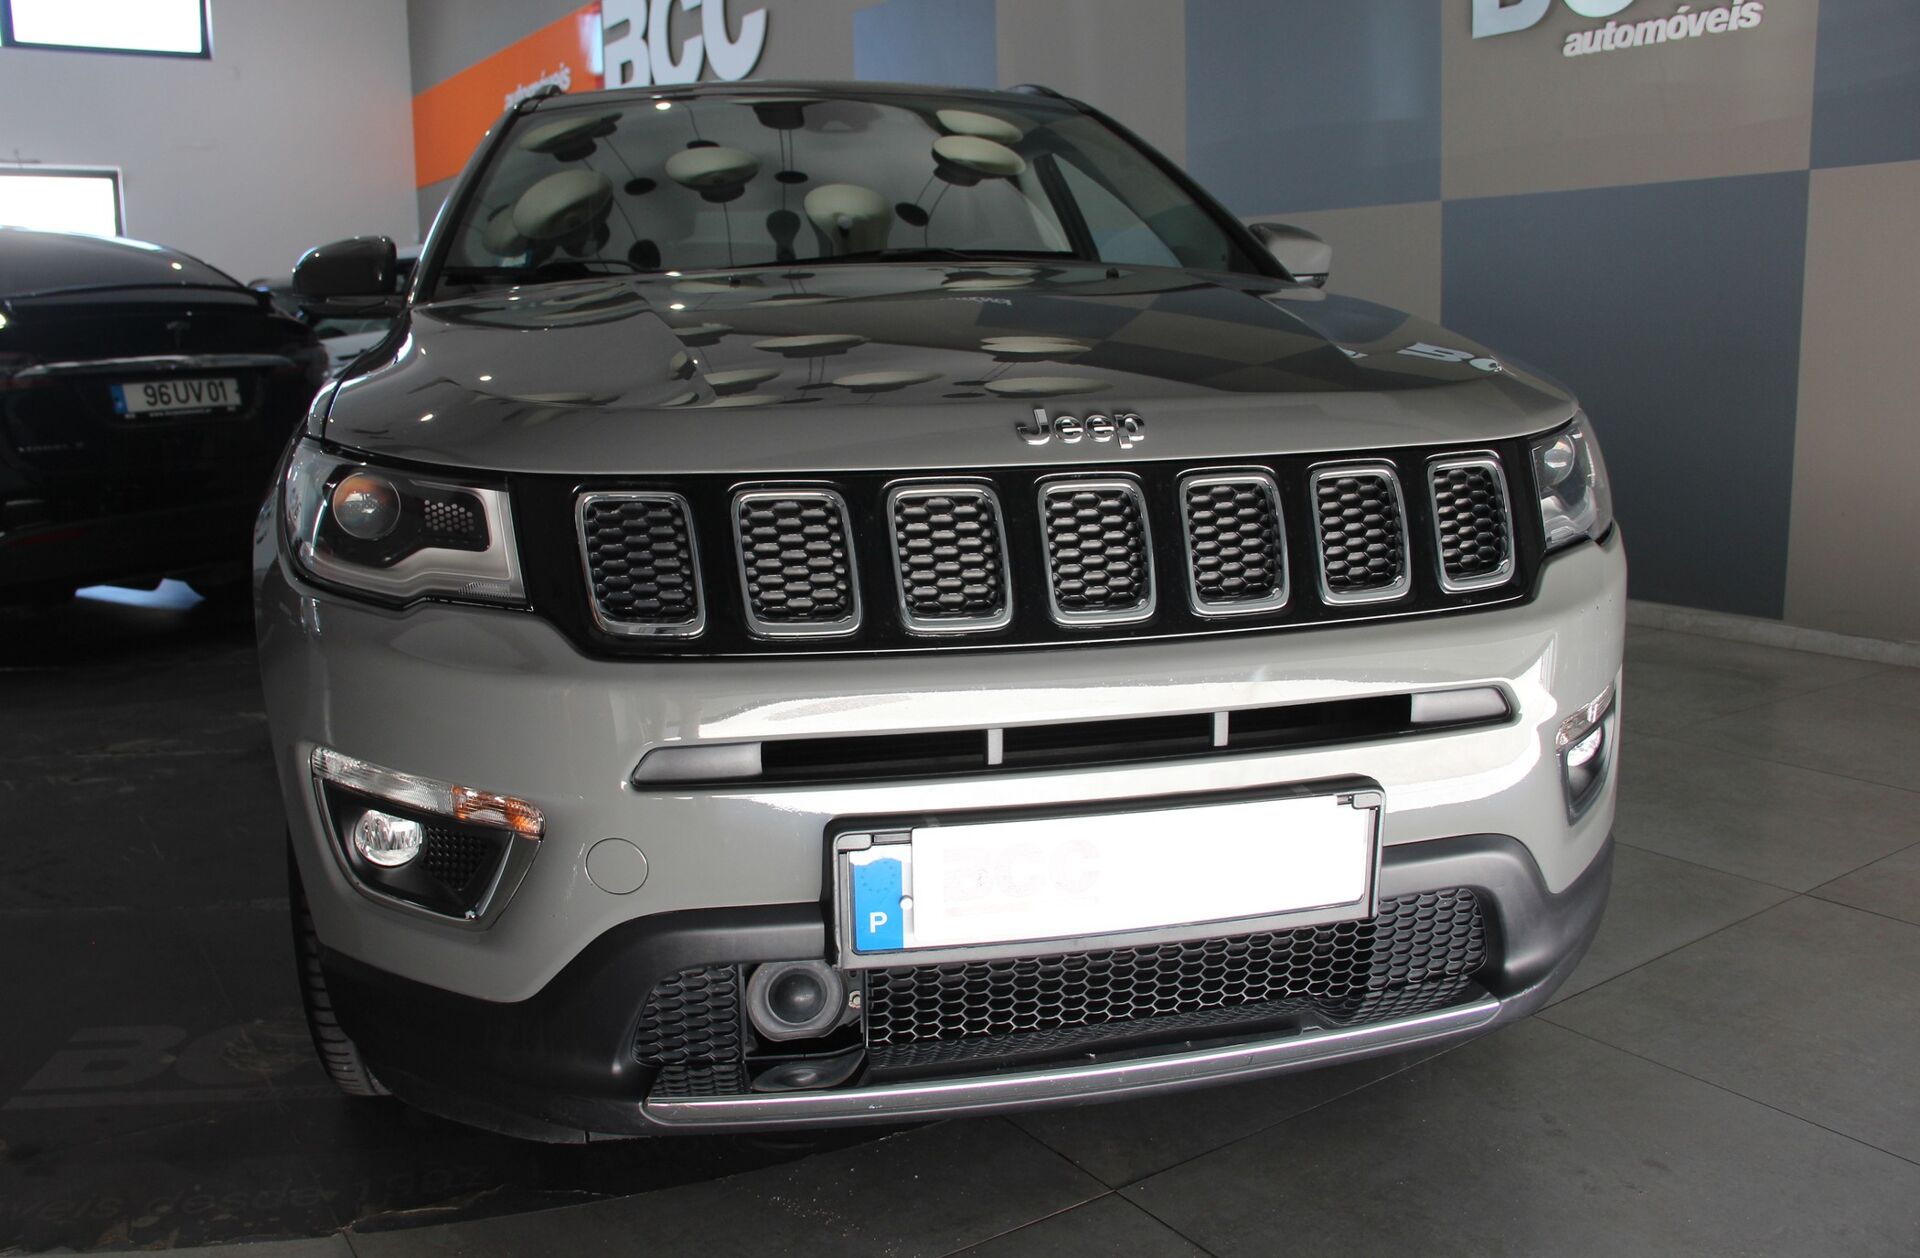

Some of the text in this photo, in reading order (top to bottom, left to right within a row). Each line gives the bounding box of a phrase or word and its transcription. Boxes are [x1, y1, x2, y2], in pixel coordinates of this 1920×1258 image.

[1563, 0, 1763, 57] automóveis
[1017, 408, 1145, 449] Jeep
[869, 911, 888, 933] P
